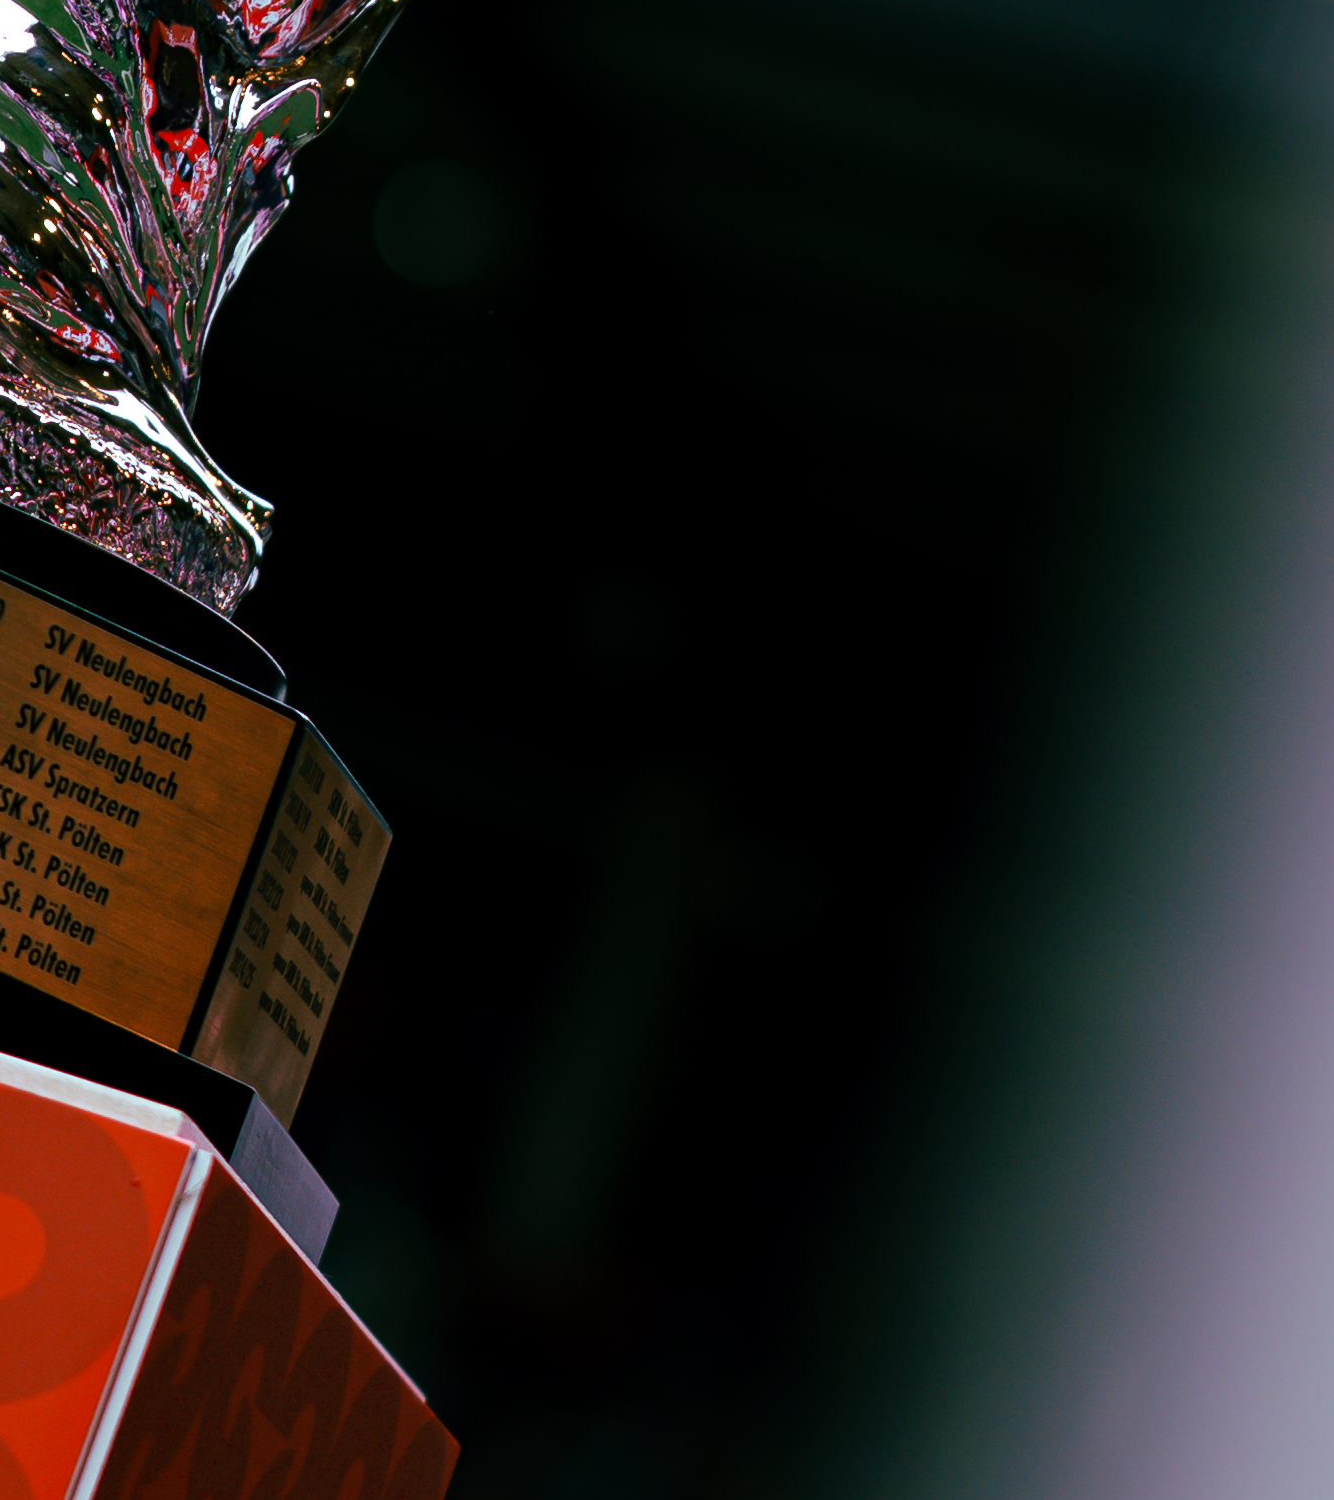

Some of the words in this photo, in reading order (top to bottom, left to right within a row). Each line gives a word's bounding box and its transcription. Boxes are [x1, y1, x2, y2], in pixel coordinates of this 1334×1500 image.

[44, 624, 76, 655] SV
[74, 638, 207, 722] Neulengbach
[29, 663, 61, 695] SV
[59, 677, 192, 761] Neulengbach
[0, 743, 45, 780] ASV
[43, 763, 140, 828] Spratzern
[14, 703, 46, 735] SV
[45, 717, 178, 800] Neulengbach
[27, 801, 51, 834] St.
[57, 815, 124, 867] Pölten
[12, 840, 36, 873] St.
[43, 854, 109, 906] Pölten
[28, 894, 96, 945] Pölten
[13, 933, 81, 985] Pölten
